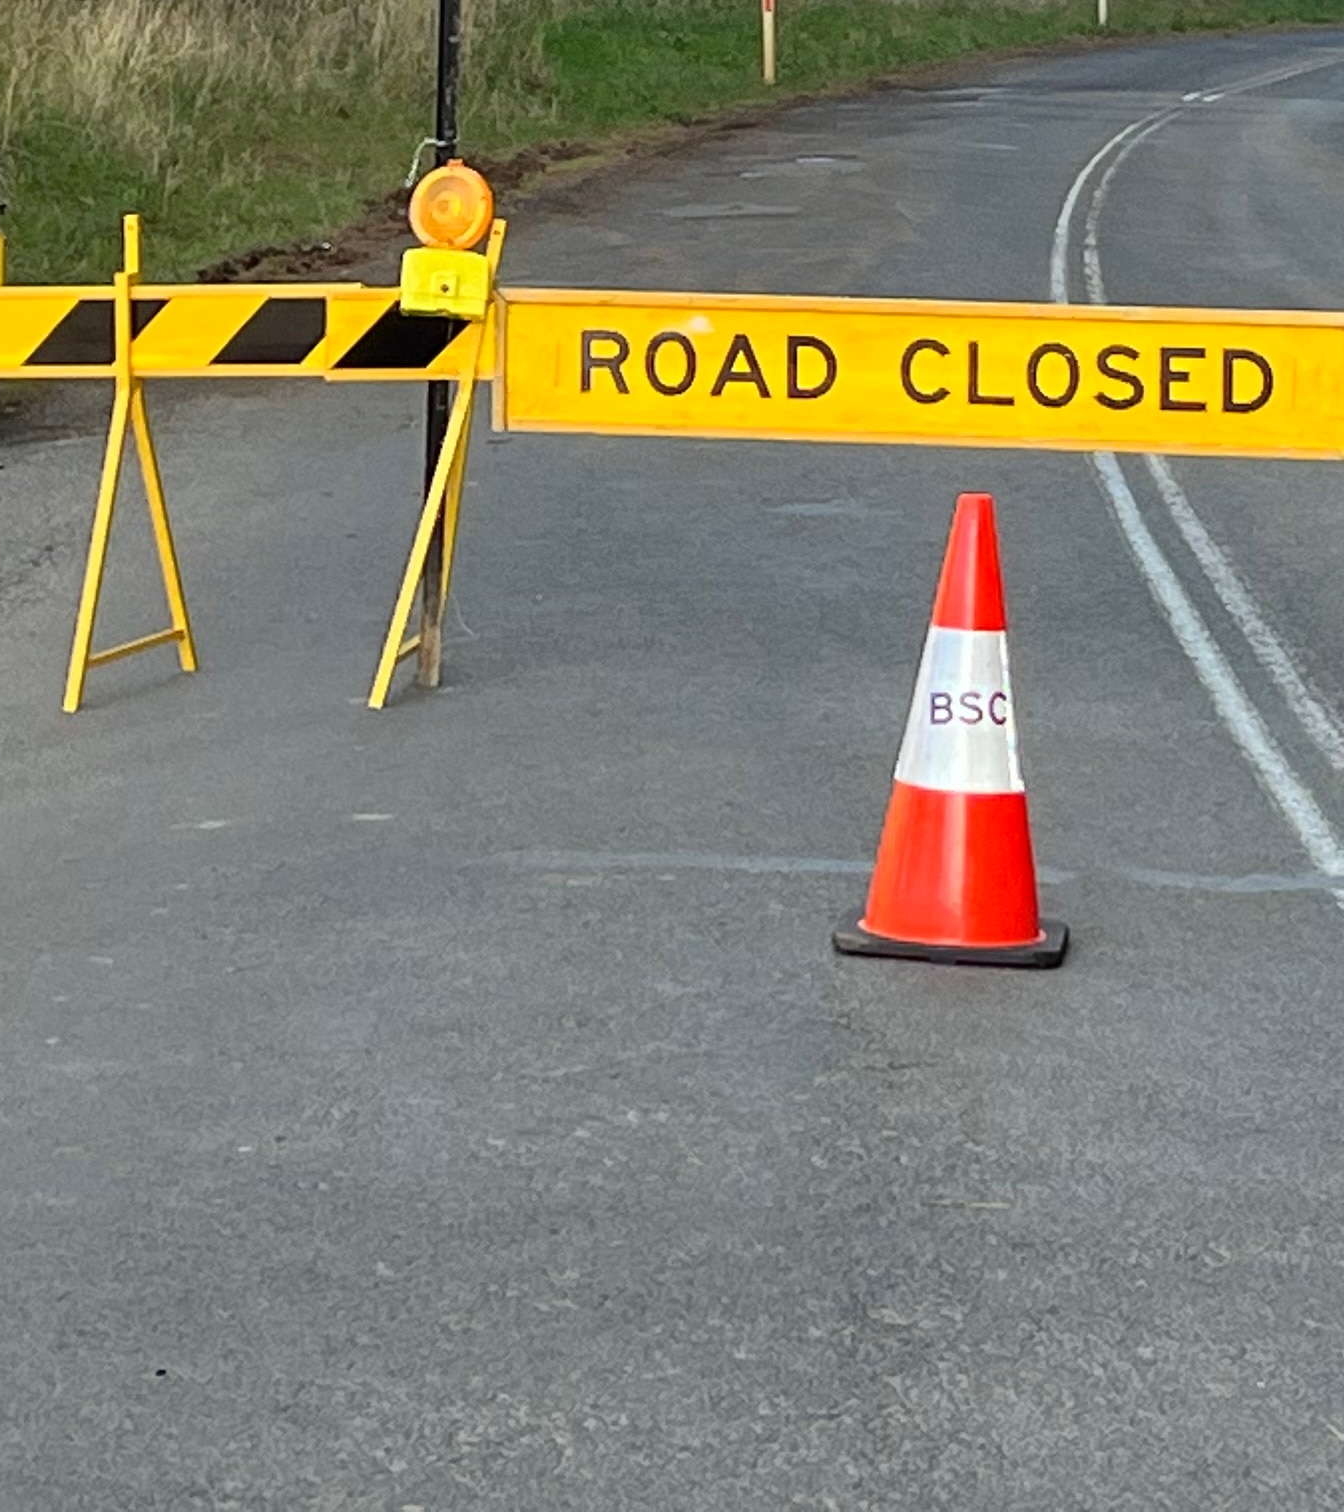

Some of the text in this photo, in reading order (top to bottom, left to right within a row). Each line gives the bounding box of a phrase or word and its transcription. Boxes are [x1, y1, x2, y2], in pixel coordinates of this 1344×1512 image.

[580, 329, 1275, 415] ROAD CLOSED
[929, 691, 1008, 726] BSC
